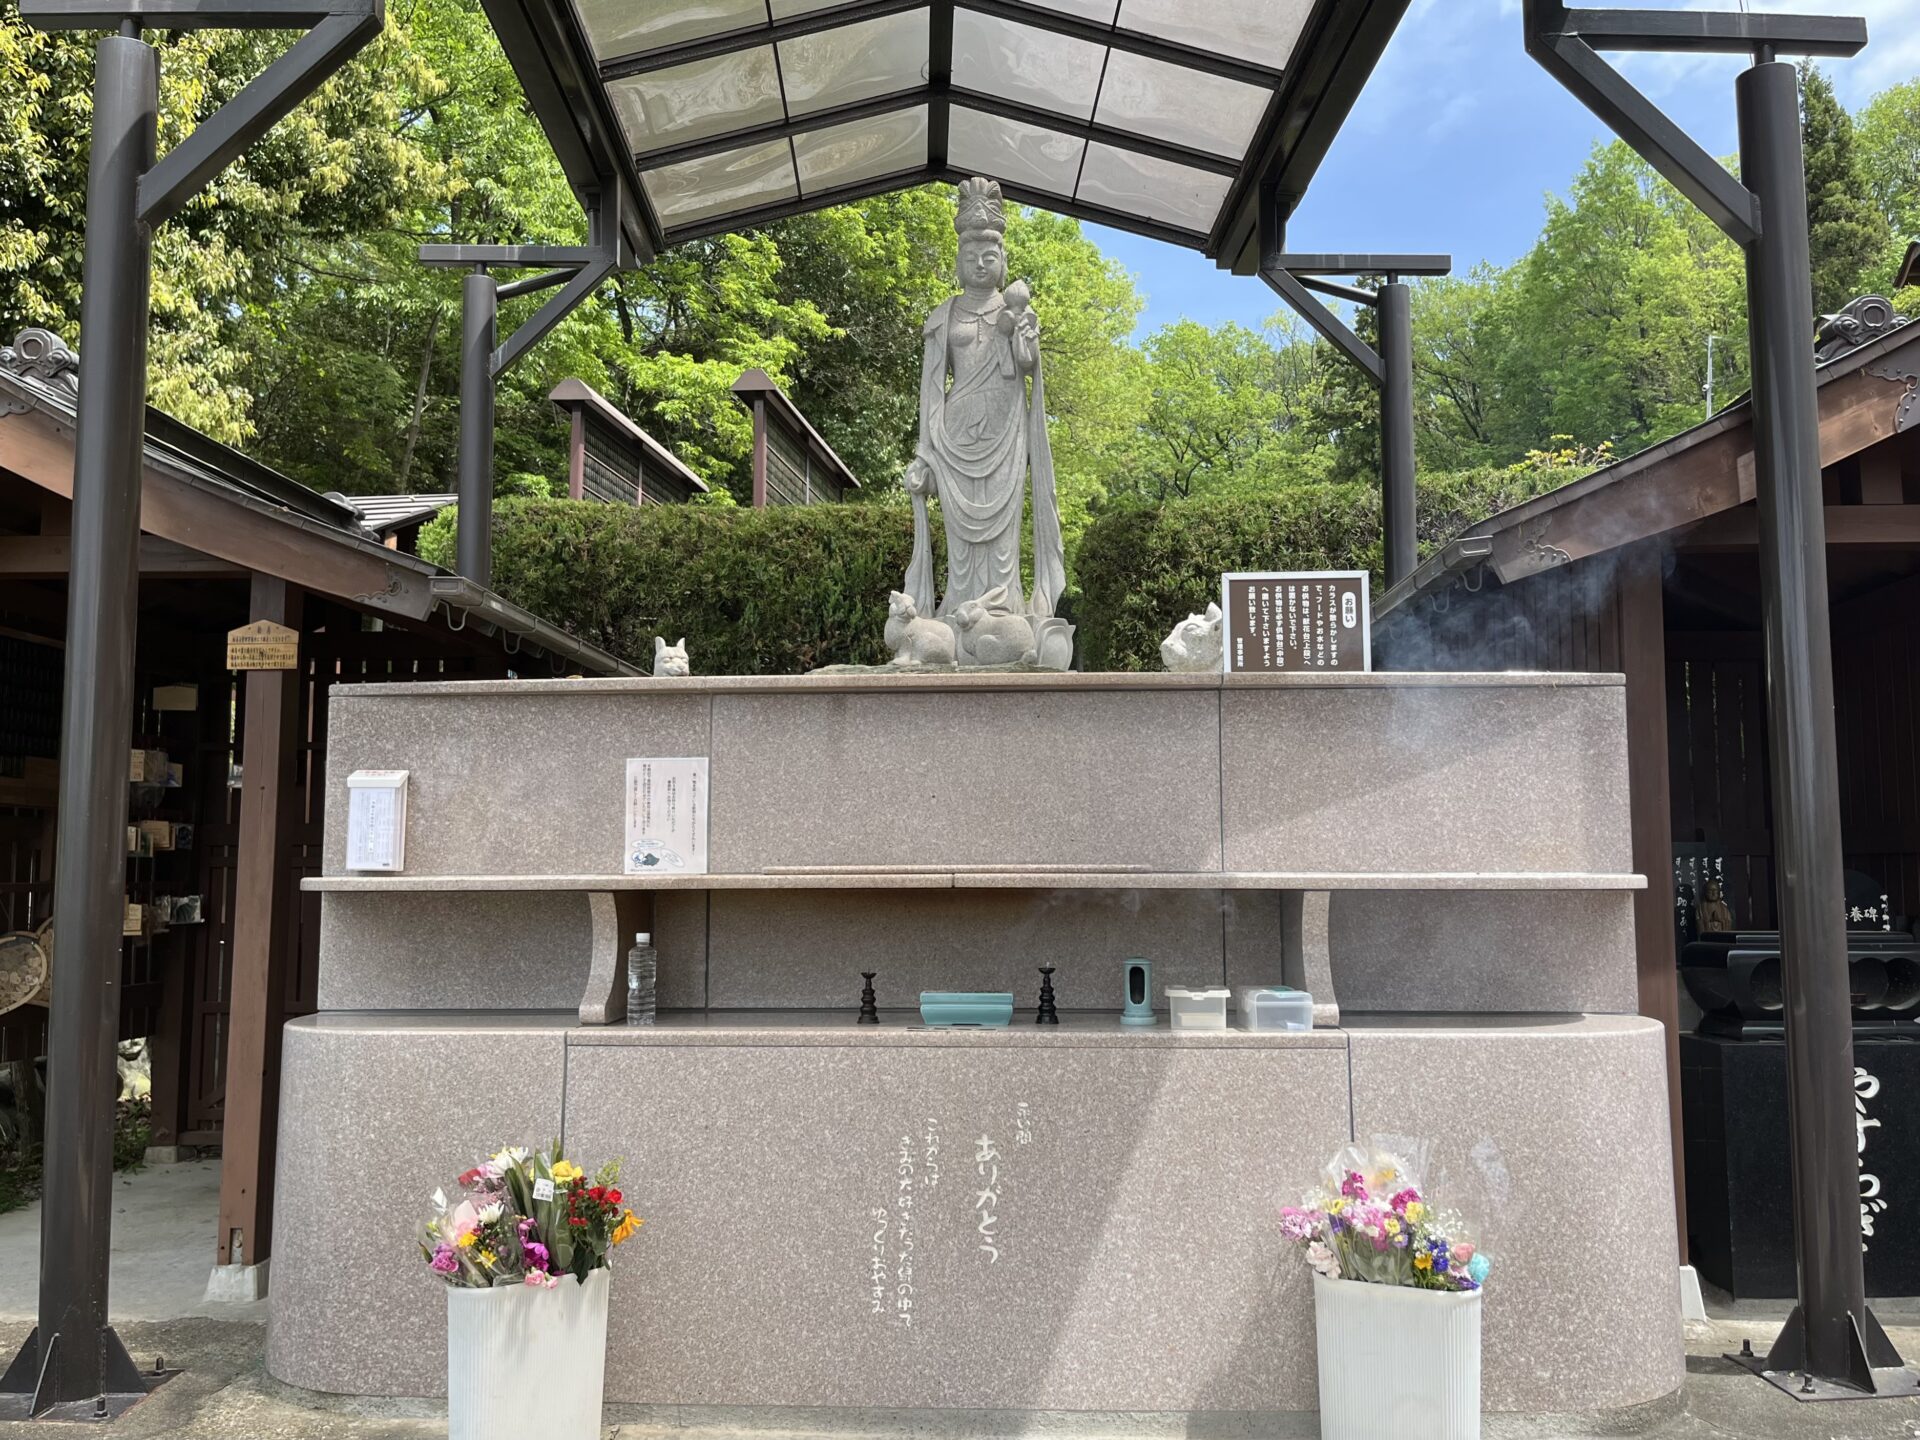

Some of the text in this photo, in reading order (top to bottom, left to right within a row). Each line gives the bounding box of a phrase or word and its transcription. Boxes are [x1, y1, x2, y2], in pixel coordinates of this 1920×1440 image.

[1248, 585, 1257, 637] お願い致します。
[1261, 586, 1271, 667] へ置いて下さいますよう
[1315, 584, 1325, 666] で、フードやお水などの
[1328, 584, 1339, 666] カラスが散らかしますの
[1345, 598, 1354, 622] お願い
[1845, 906, 1879, 923] 養碑
[925, 1118, 940, 1186] これからは
[975, 1133, 1002, 1264] ありがとう
[871, 1207, 887, 1313] ゆっくりおやすみ
